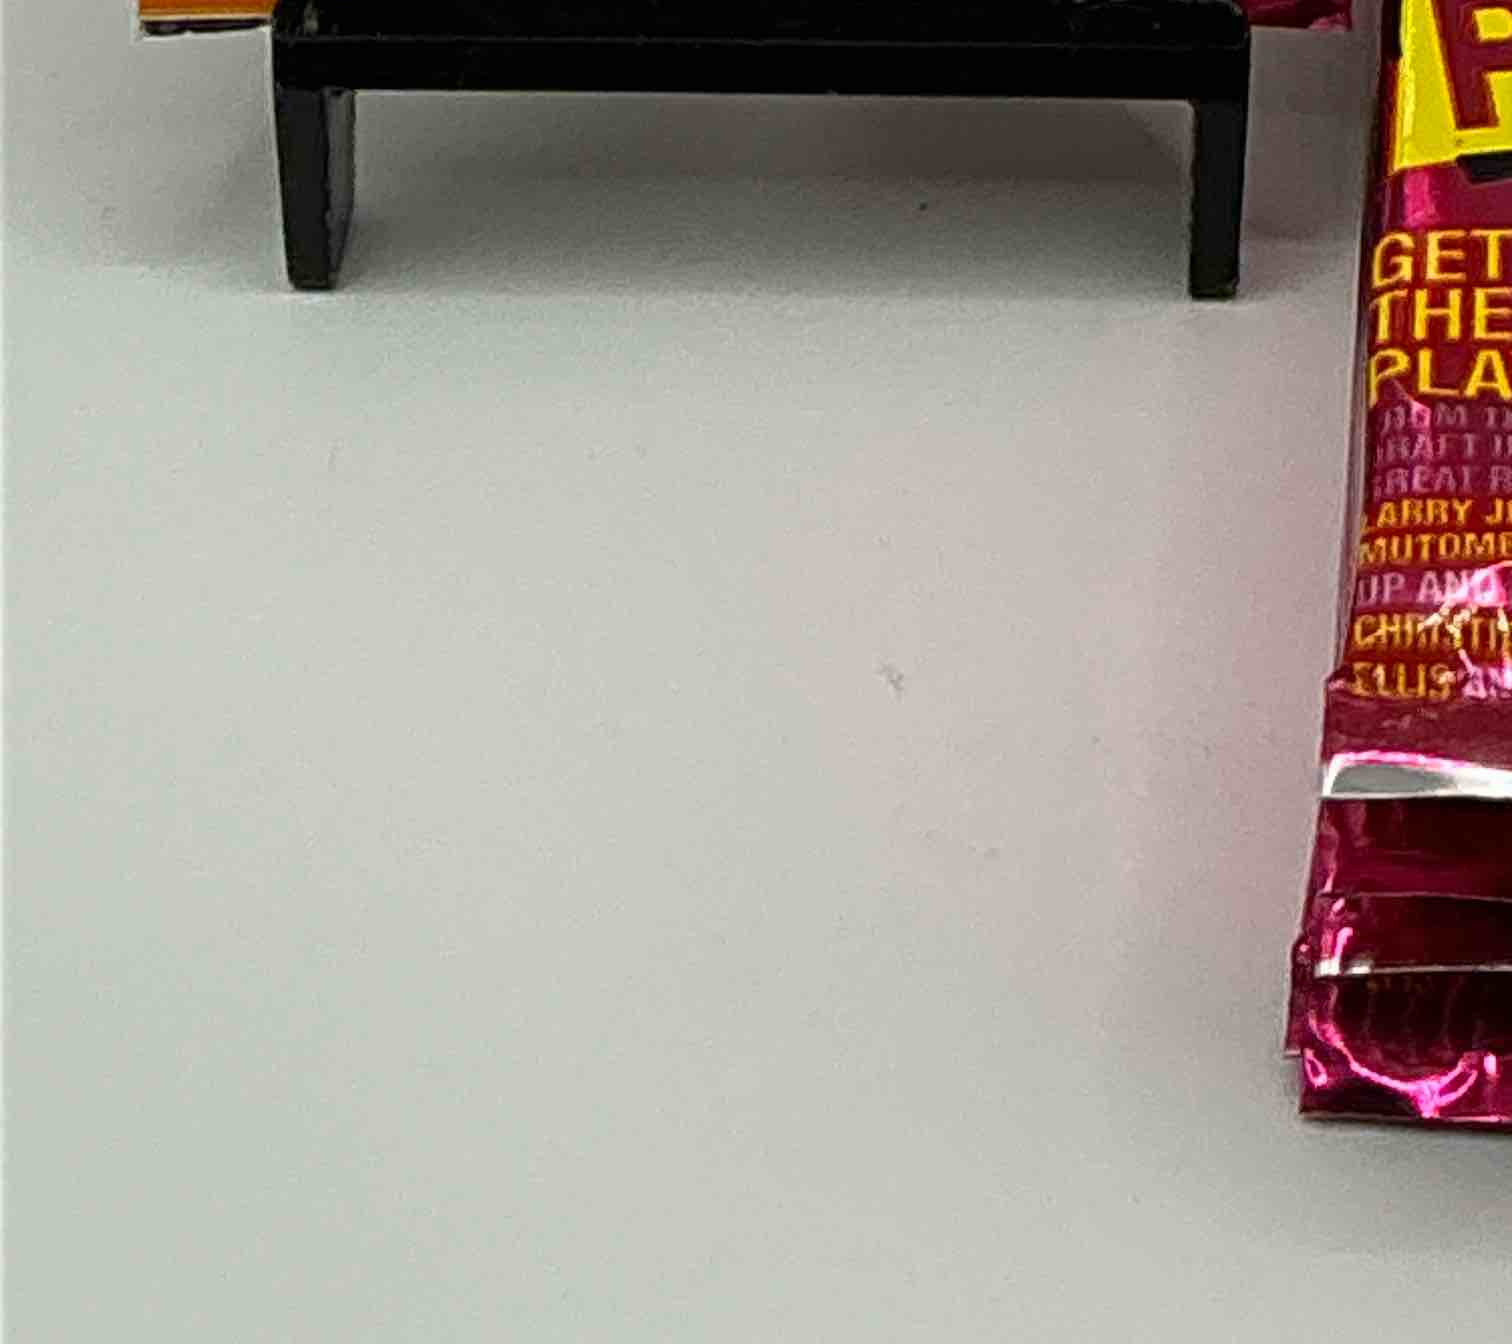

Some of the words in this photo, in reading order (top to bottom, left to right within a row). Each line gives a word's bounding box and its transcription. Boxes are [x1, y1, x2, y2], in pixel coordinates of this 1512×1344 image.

[1376, 404, 1468, 434] ROM
[1374, 434, 1475, 466] RAFT
[1357, 571, 1405, 605] UP
[1417, 569, 1499, 604] AND
[1350, 662, 1451, 699] ELLIS
